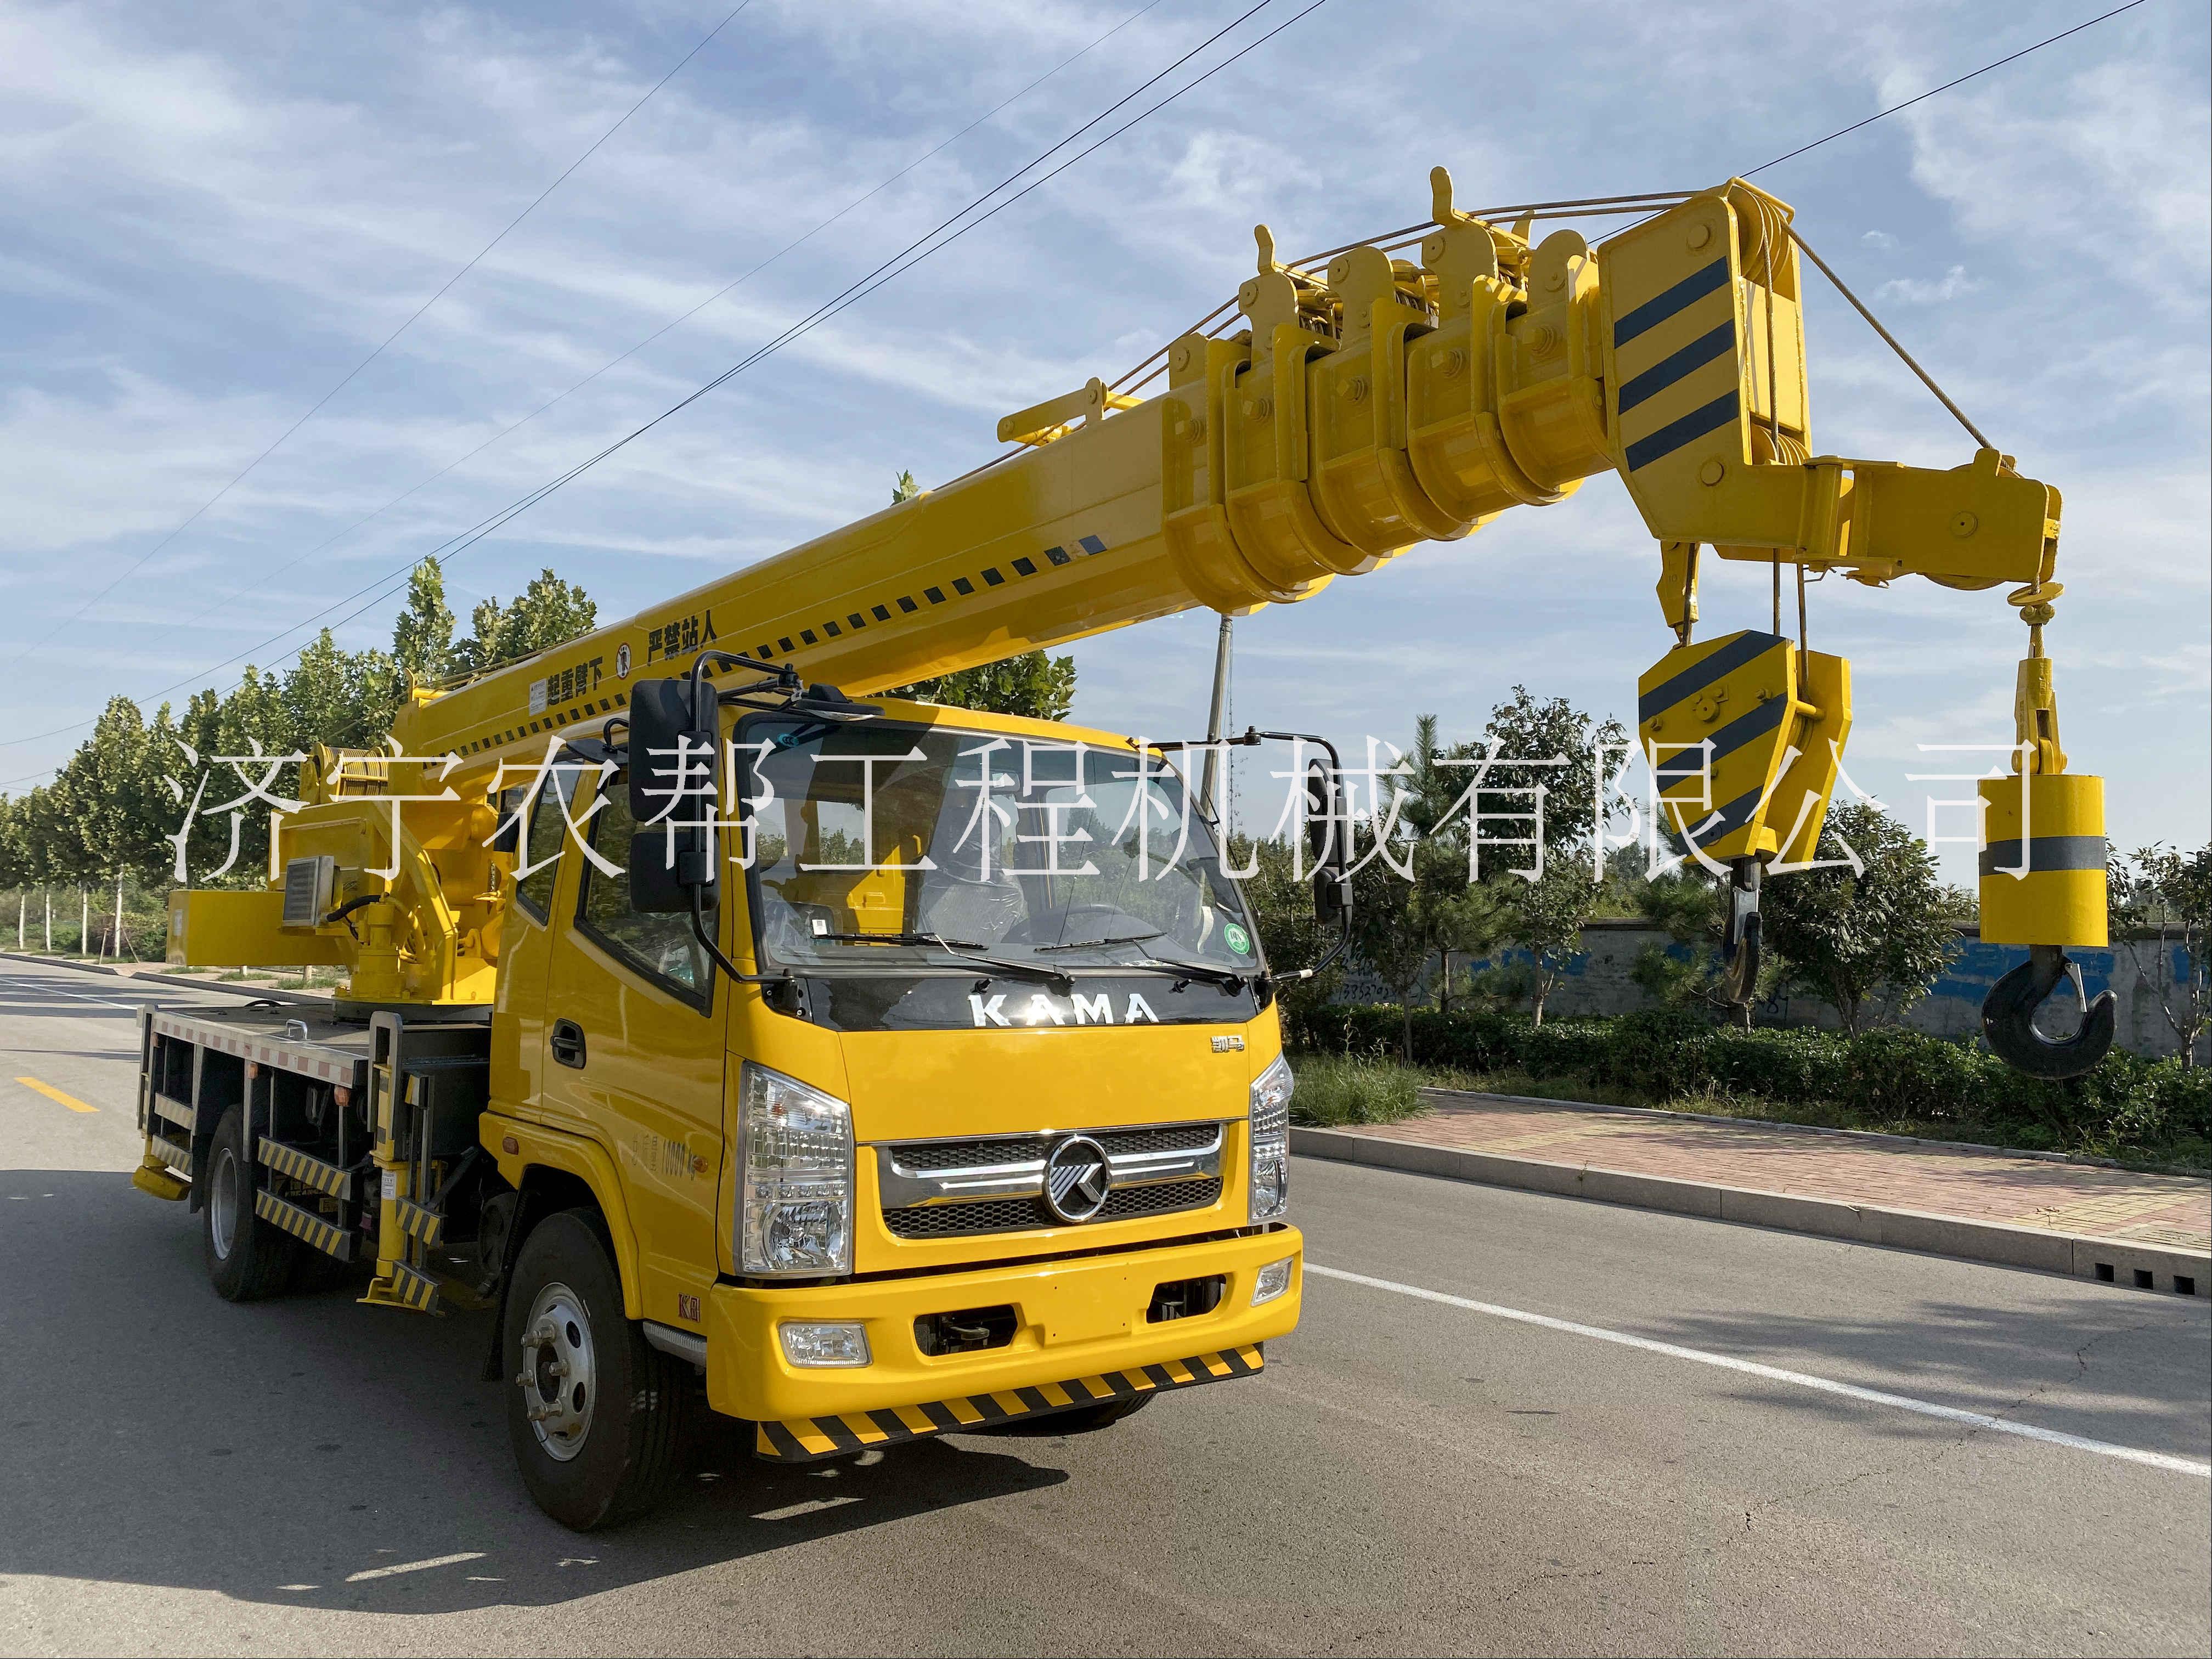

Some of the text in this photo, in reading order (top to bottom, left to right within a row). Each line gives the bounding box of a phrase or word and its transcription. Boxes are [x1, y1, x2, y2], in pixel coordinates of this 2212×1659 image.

[548, 655, 603, 707] 起重臂下
[647, 609, 717, 666] 严禁站人
[967, 994, 1160, 1026] KAMA
[1210, 1035, 1245, 1053] 凯马
